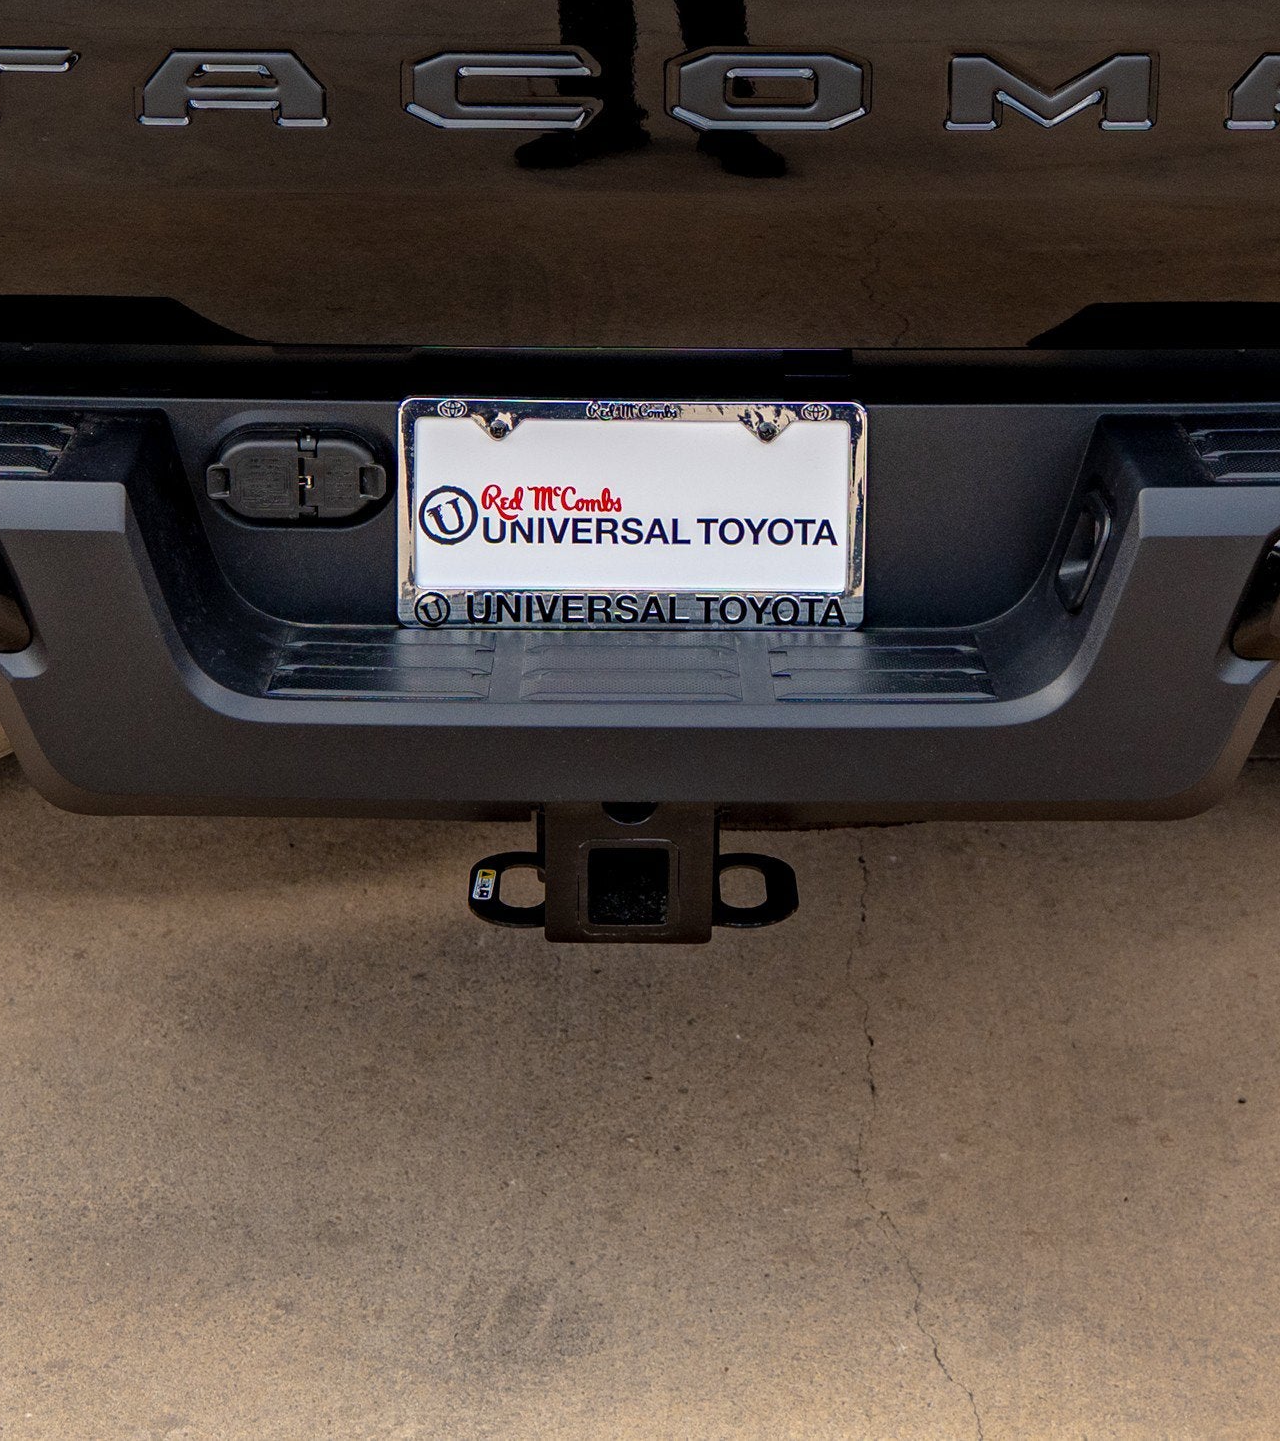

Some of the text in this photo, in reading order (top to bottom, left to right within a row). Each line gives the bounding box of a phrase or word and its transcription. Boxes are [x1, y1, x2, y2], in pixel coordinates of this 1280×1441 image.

[586, 400, 615, 421] Red
[481, 484, 622, 521] Red McCombs
[483, 517, 839, 546] UNIVERSAL TOYOTA
[466, 592, 848, 627] UNIVERSAL TOYOTA
